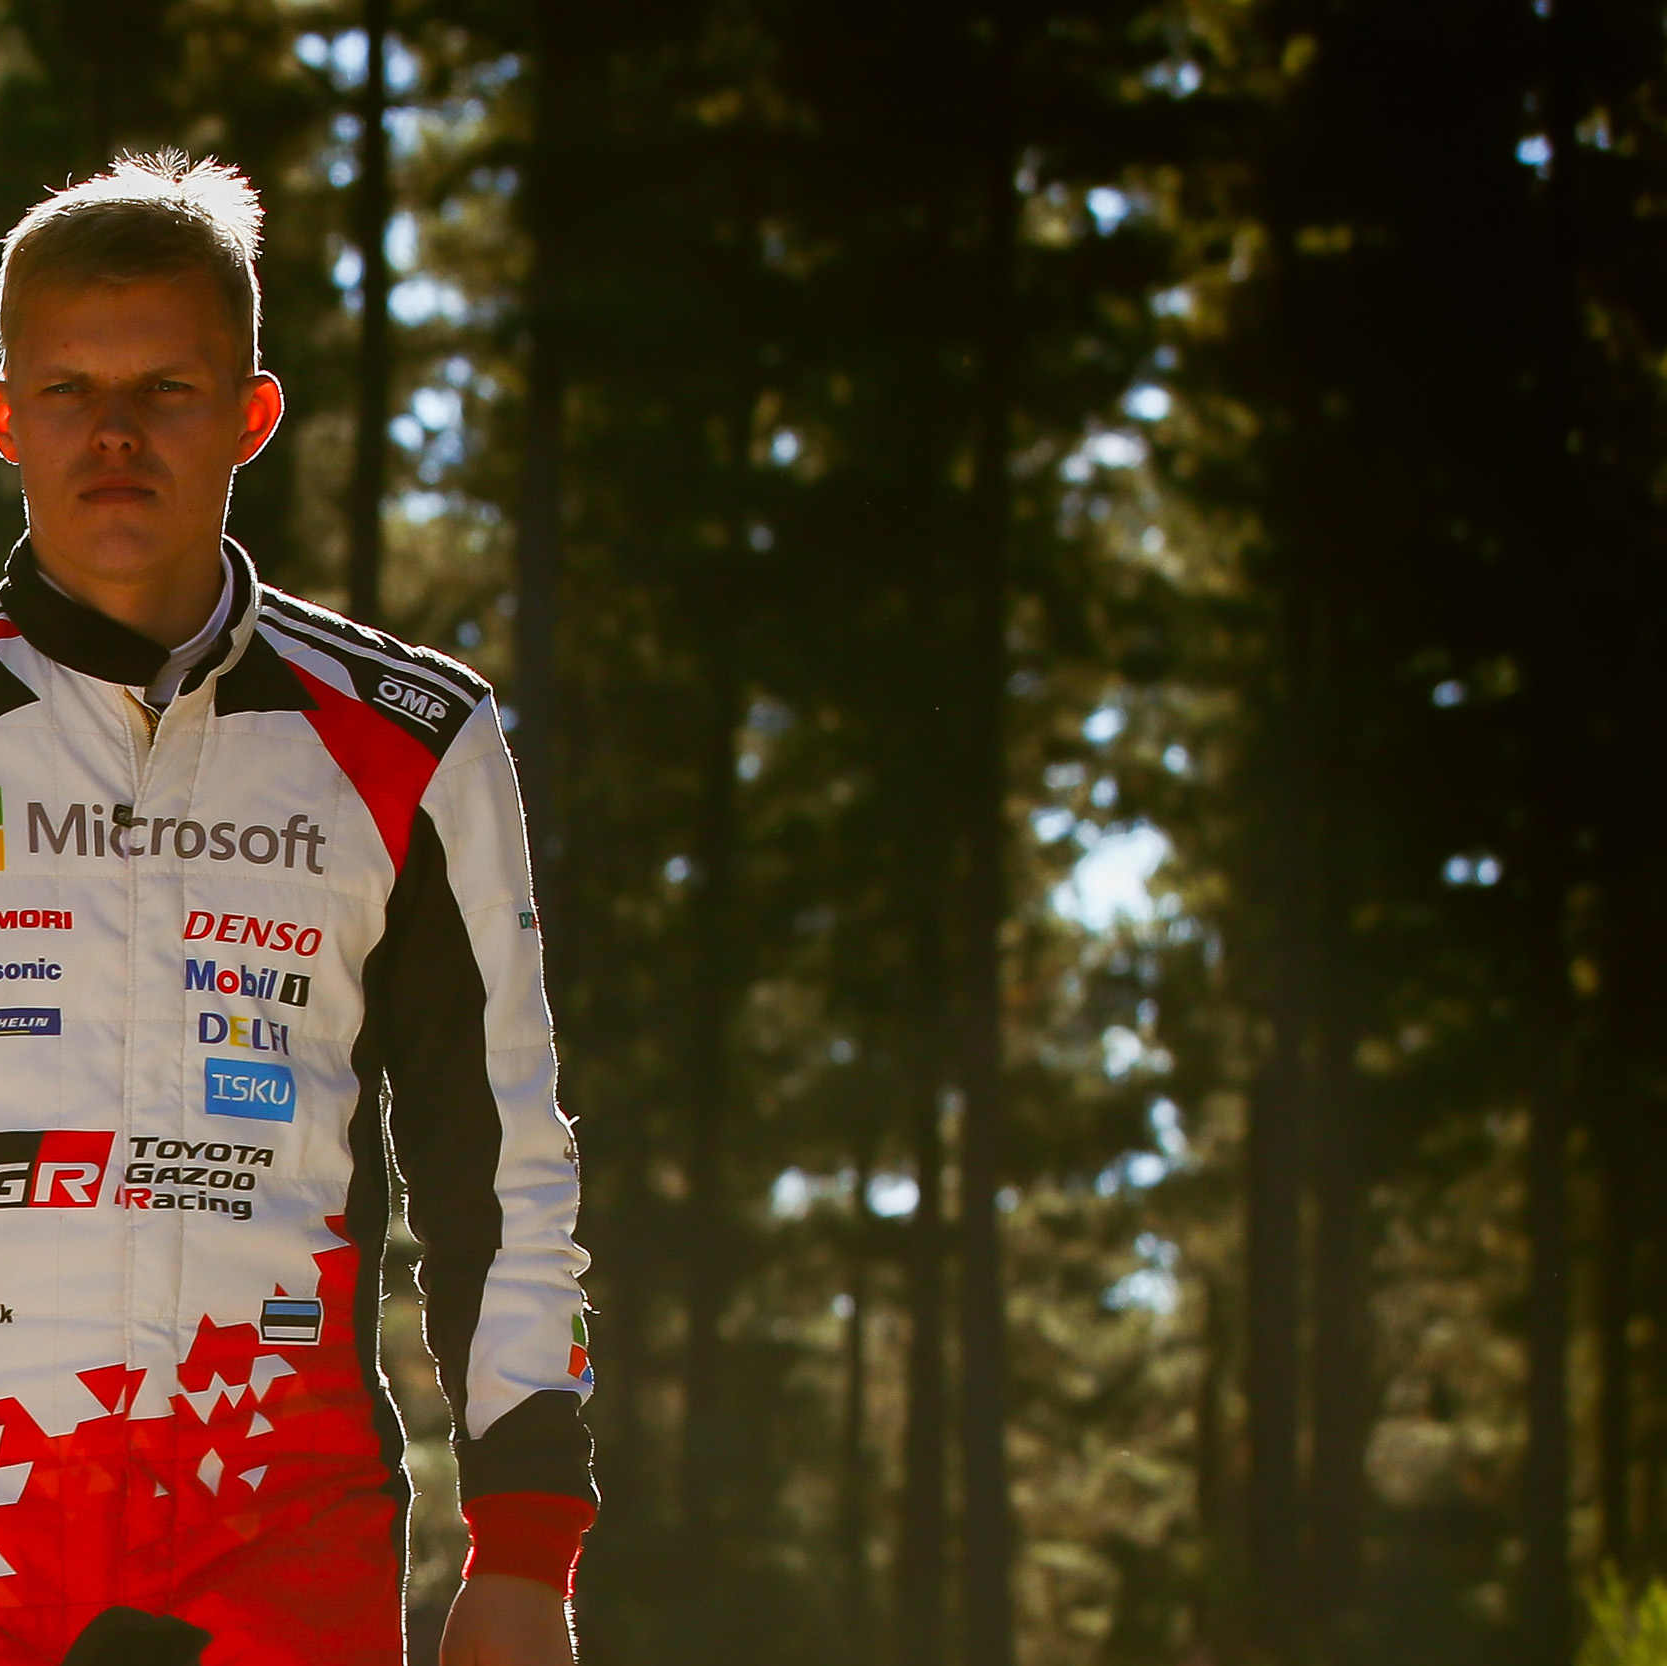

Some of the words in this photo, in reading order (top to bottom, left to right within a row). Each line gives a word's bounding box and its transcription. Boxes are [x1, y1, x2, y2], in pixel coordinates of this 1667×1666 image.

[378, 681, 446, 720] OMP
[26, 801, 327, 876] Microsoft
[183, 911, 323, 957] DENSO
[185, 958, 279, 1000] Mobil
[211, 1072, 291, 1105] ISKU
[129, 1136, 275, 1168] TOYOTA
[124, 1162, 257, 1192] GAZOO
[114, 1184, 253, 1222] Racing
